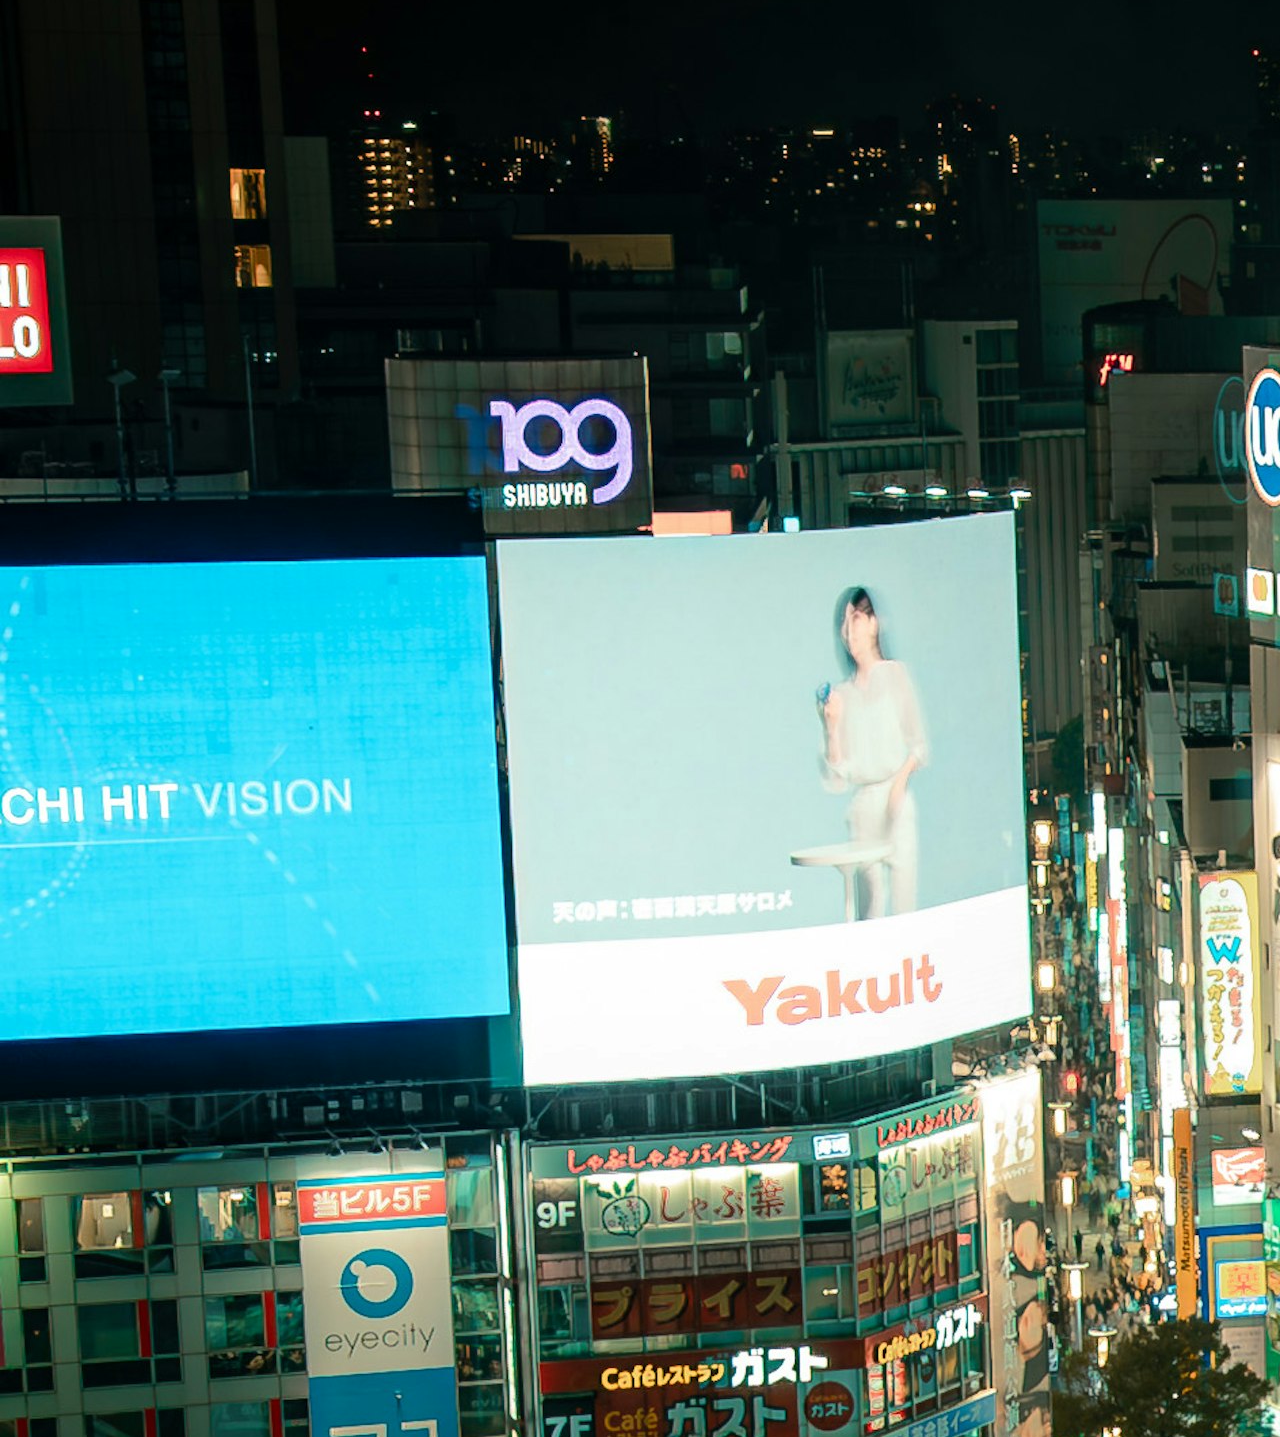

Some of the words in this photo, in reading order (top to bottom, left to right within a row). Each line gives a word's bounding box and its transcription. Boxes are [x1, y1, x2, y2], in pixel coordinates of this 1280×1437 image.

[489, 398, 634, 505] 109
[503, 482, 588, 507] SHIBUYA
[102, 782, 178, 821] HIT
[193, 777, 353, 817] VISION
[721, 955, 944, 1028] Yakult
[567, 1135, 793, 1175] しゃぶしゃぶバイキング
[312, 1185, 432, 1219] 当ビル5F
[536, 1200, 576, 1230] 9F
[660, 1177, 786, 1222] しゃぶ葉
[857, 1239, 954, 1304] コンタクト
[593, 1276, 796, 1329] プライス
[323, 1324, 436, 1360] eyecity
[936, 1303, 984, 1351] ガスト
[729, 1346, 829, 1387] ガスト
[604, 1407, 658, 1433] Café
[810, 1400, 849, 1420] ガスト
